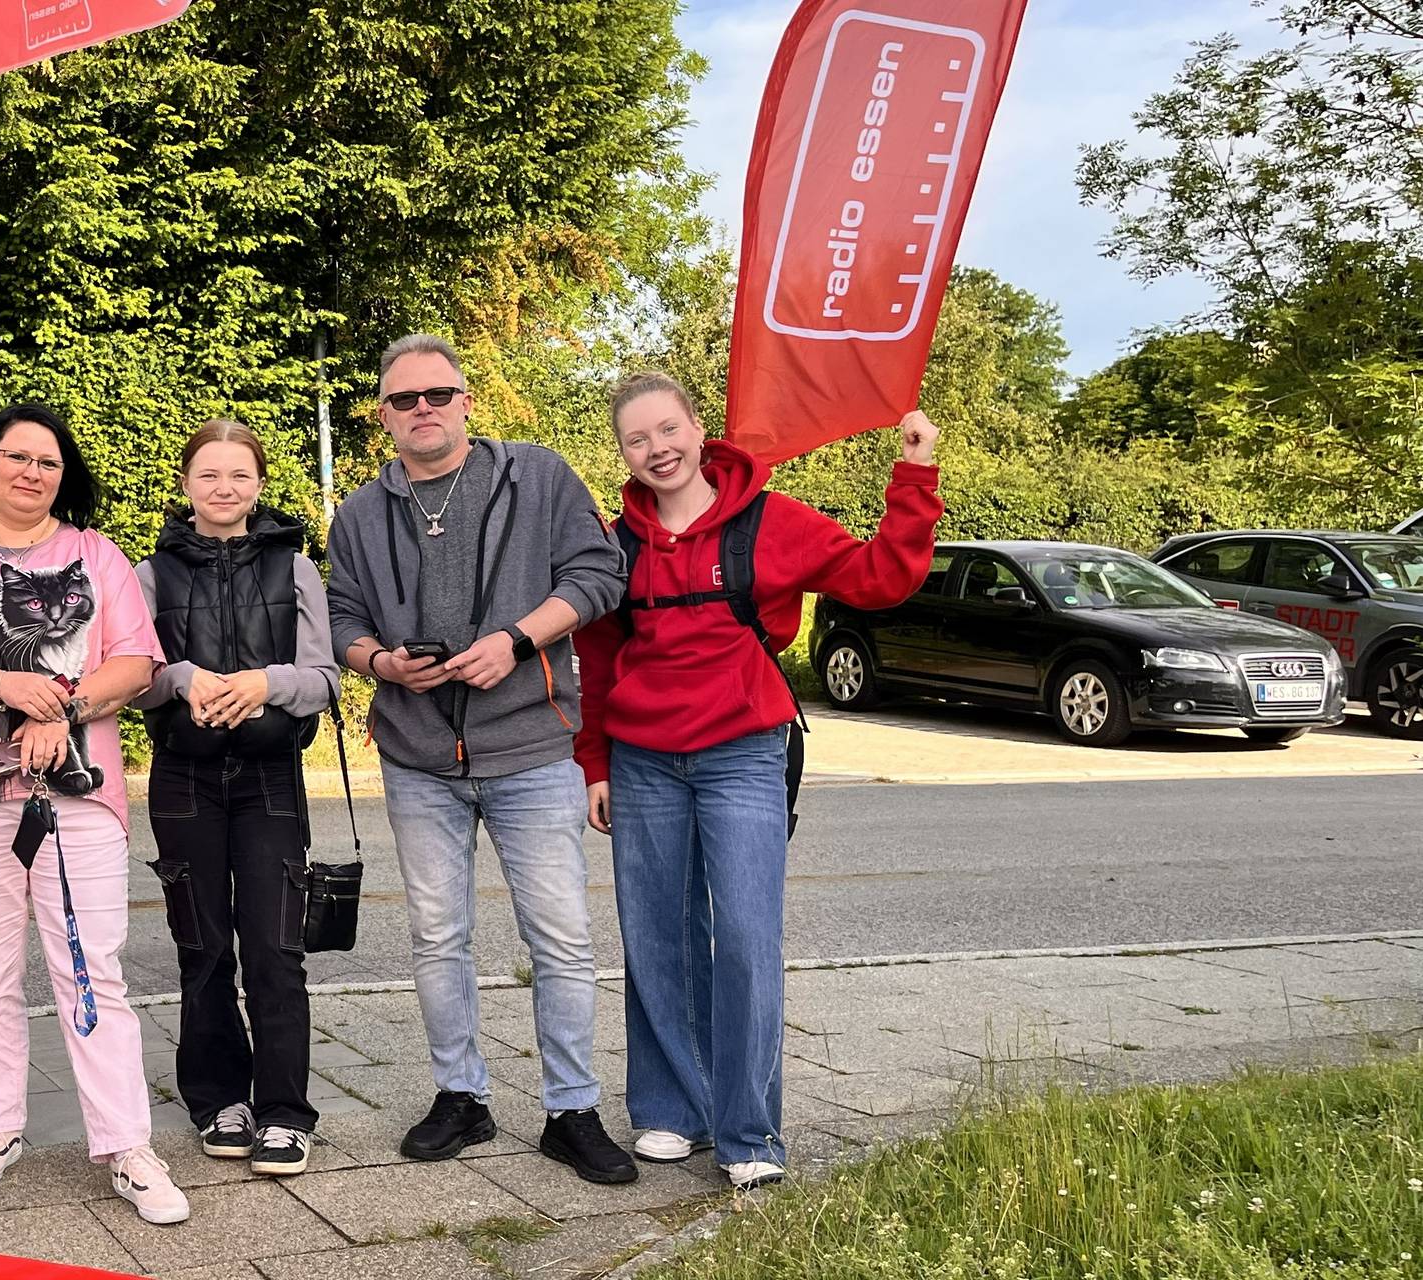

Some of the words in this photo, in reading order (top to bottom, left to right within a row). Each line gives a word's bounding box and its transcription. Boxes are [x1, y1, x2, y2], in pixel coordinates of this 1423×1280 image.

[823, 200, 865, 317] radio
[850, 41, 904, 182] essen
[1276, 605, 1361, 634] STADT
